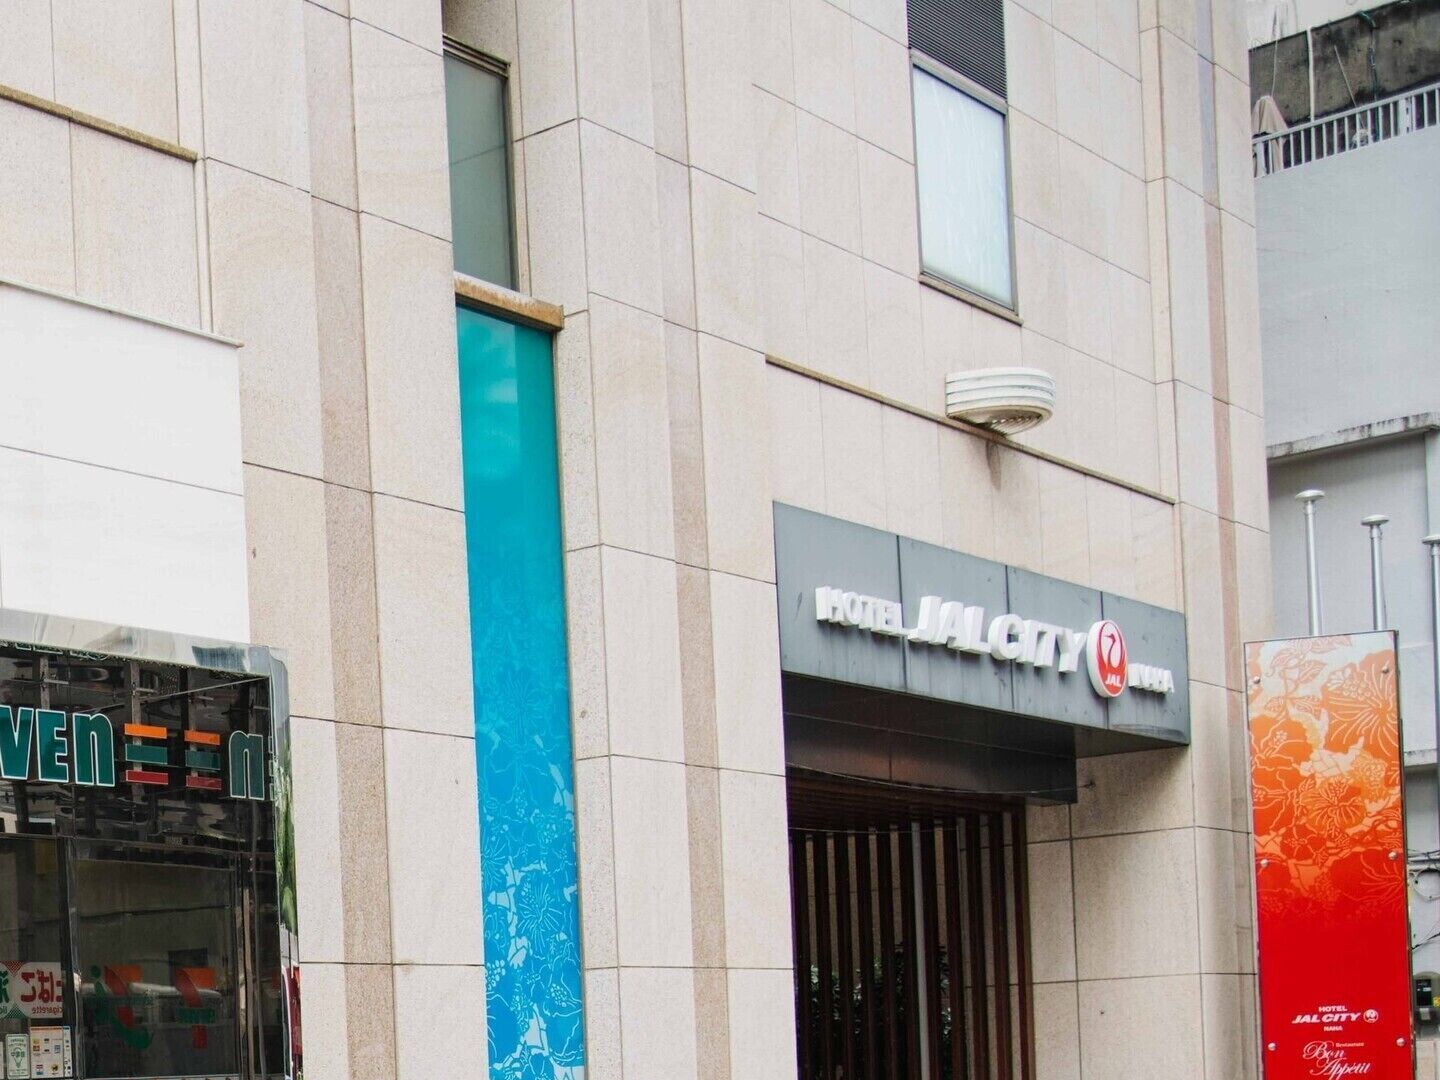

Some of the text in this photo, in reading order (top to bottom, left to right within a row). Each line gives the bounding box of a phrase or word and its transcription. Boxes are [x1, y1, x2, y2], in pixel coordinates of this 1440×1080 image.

[815, 586, 906, 636] HOTEL
[907, 595, 991, 655] JAL
[988, 612, 1087, 673] CITY
[1105, 675, 1122, 688] JAL
[1291, 1012, 1361, 1024] JAL CITY
[1303, 1040, 1347, 1060] Bon
